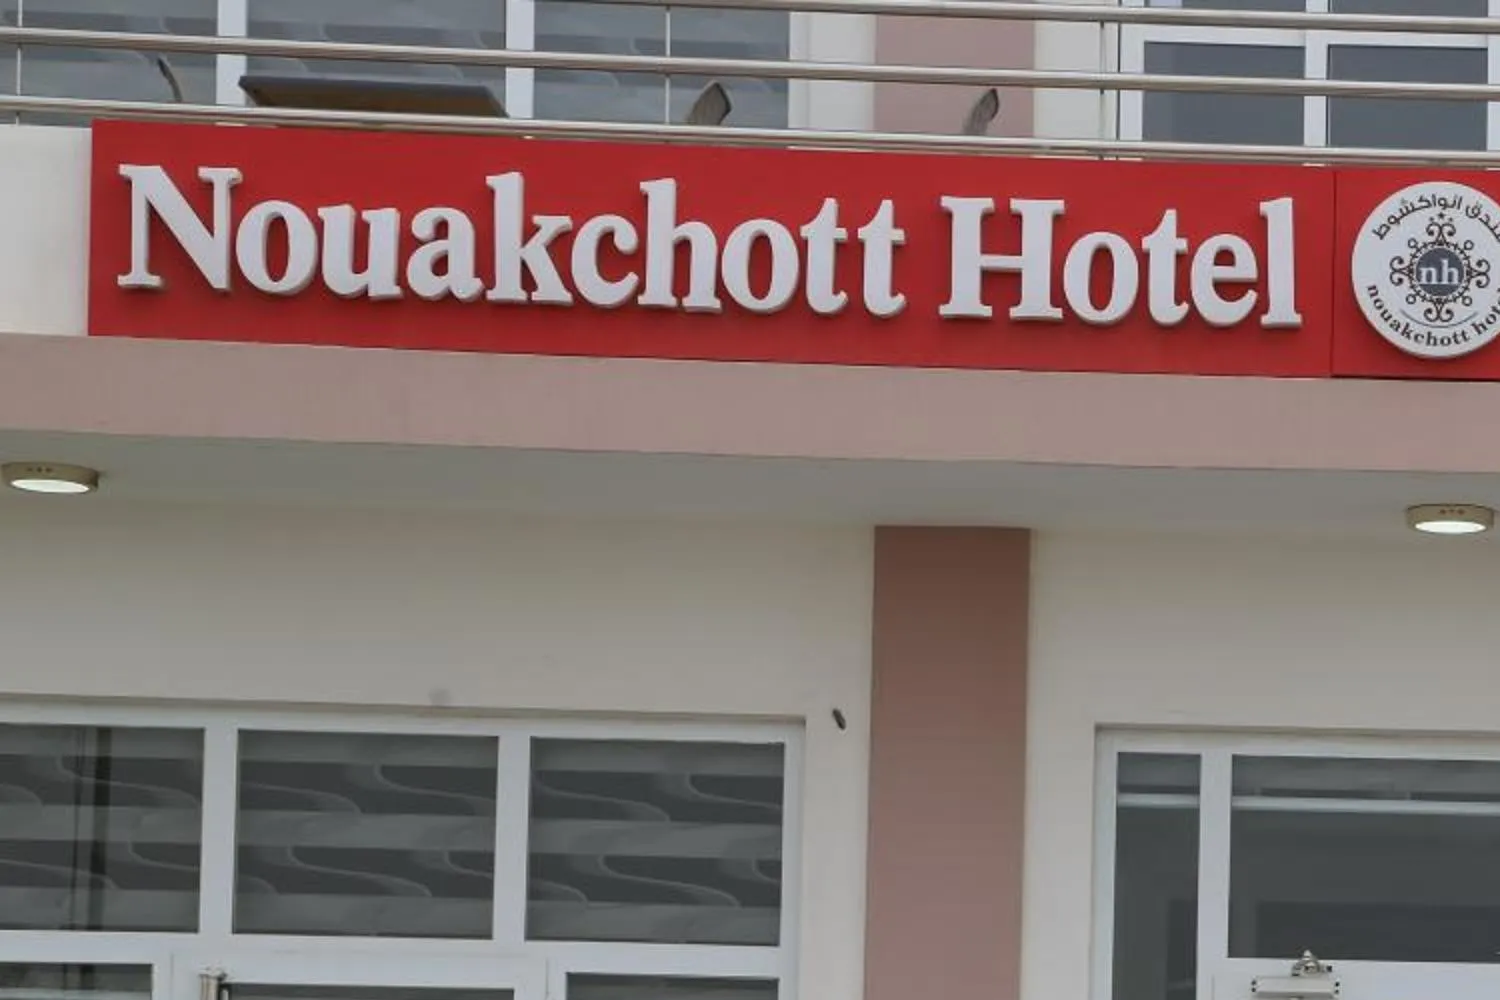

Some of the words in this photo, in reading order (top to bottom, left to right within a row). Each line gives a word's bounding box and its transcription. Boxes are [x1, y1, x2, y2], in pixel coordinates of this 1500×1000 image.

[119, 165, 904, 314] Nouakchott
[940, 197, 1300, 324] Hotel
[1418, 257, 1460, 286] nh
[1367, 285, 1472, 347] nouakchott
